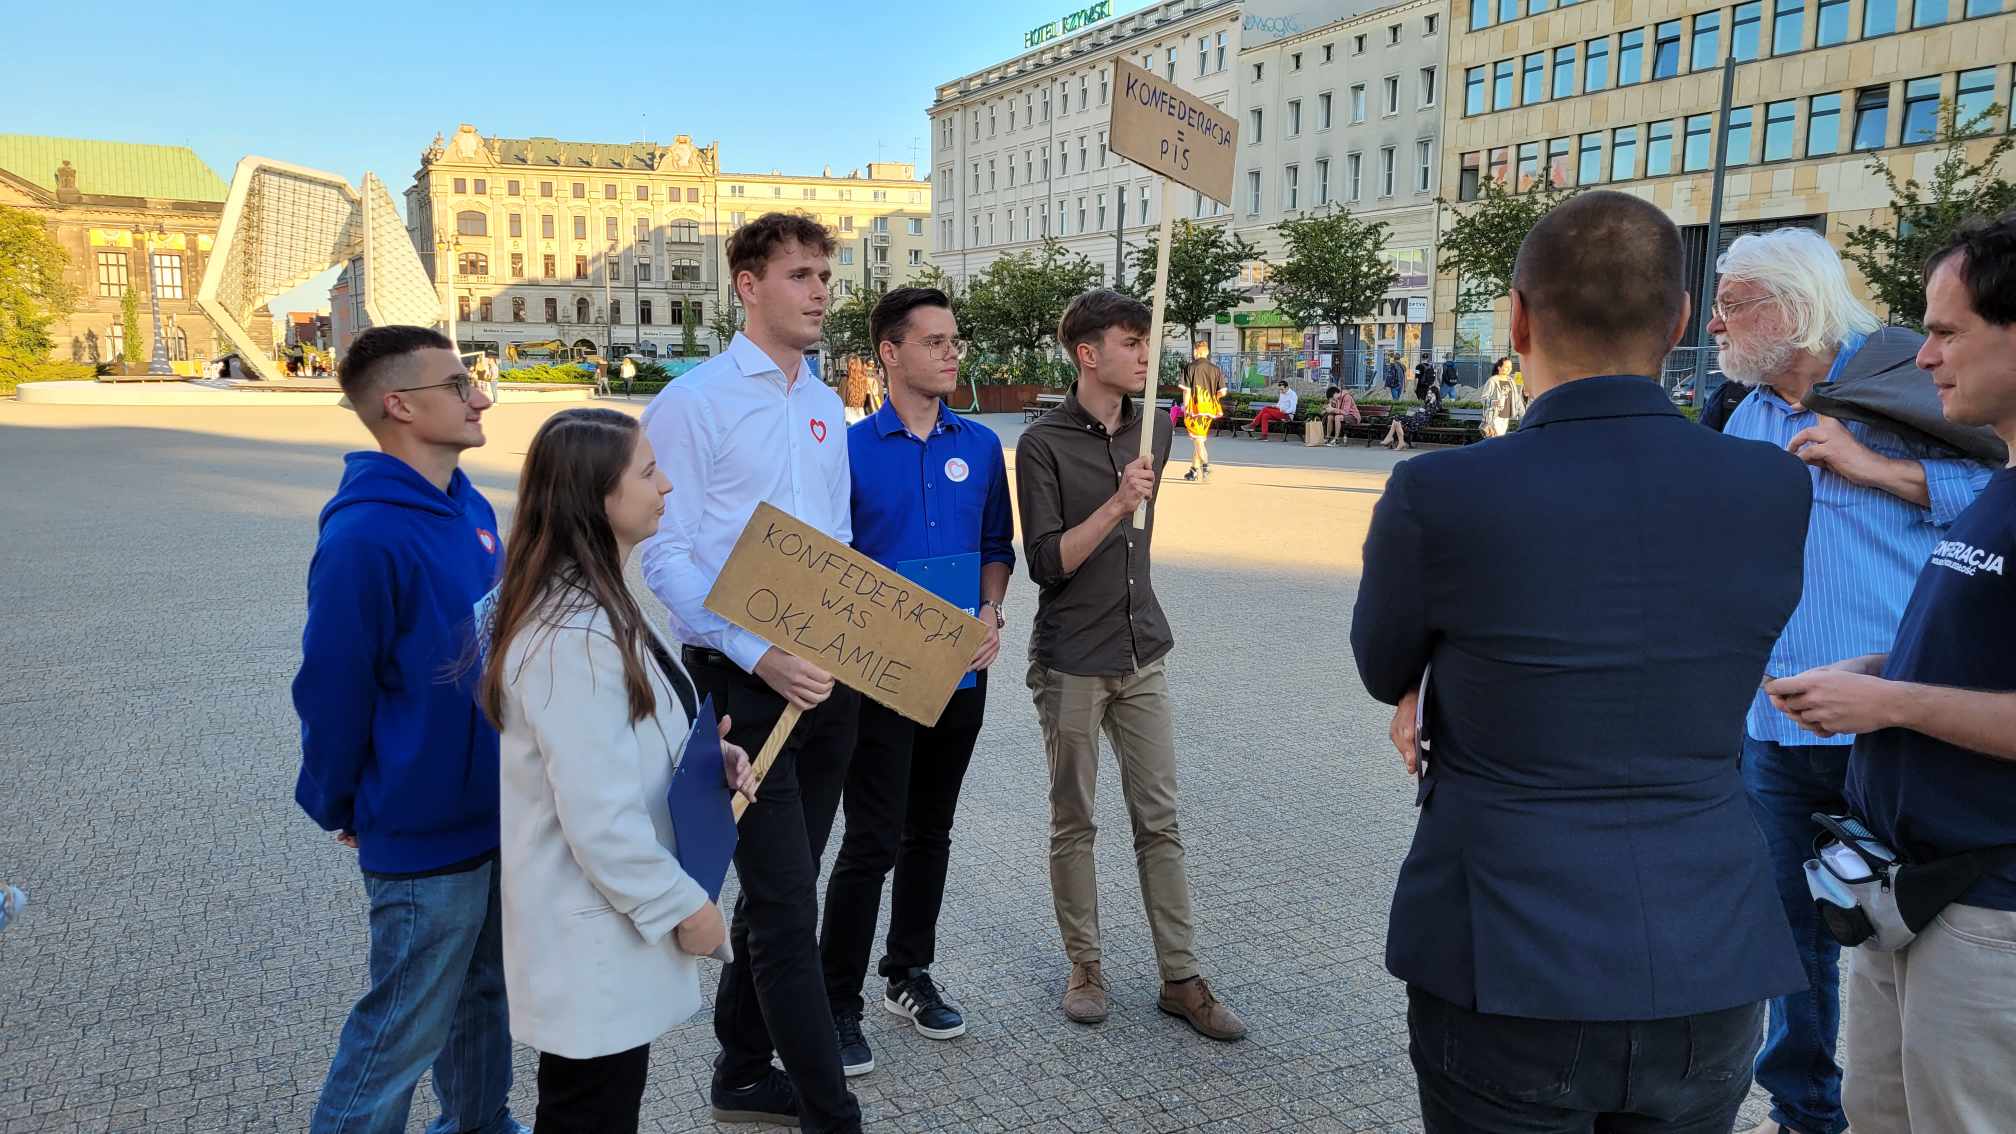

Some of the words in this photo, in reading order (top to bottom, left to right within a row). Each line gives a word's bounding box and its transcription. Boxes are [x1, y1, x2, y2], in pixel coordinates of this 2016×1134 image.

[1024, 21, 1057, 49] HOTEL
[1125, 72, 1232, 149] KONFEDERACJA
[761, 522, 964, 648] KONFEDERACJA
[820, 587, 873, 629] WAS
[746, 588, 912, 695] OKŁAMIE
